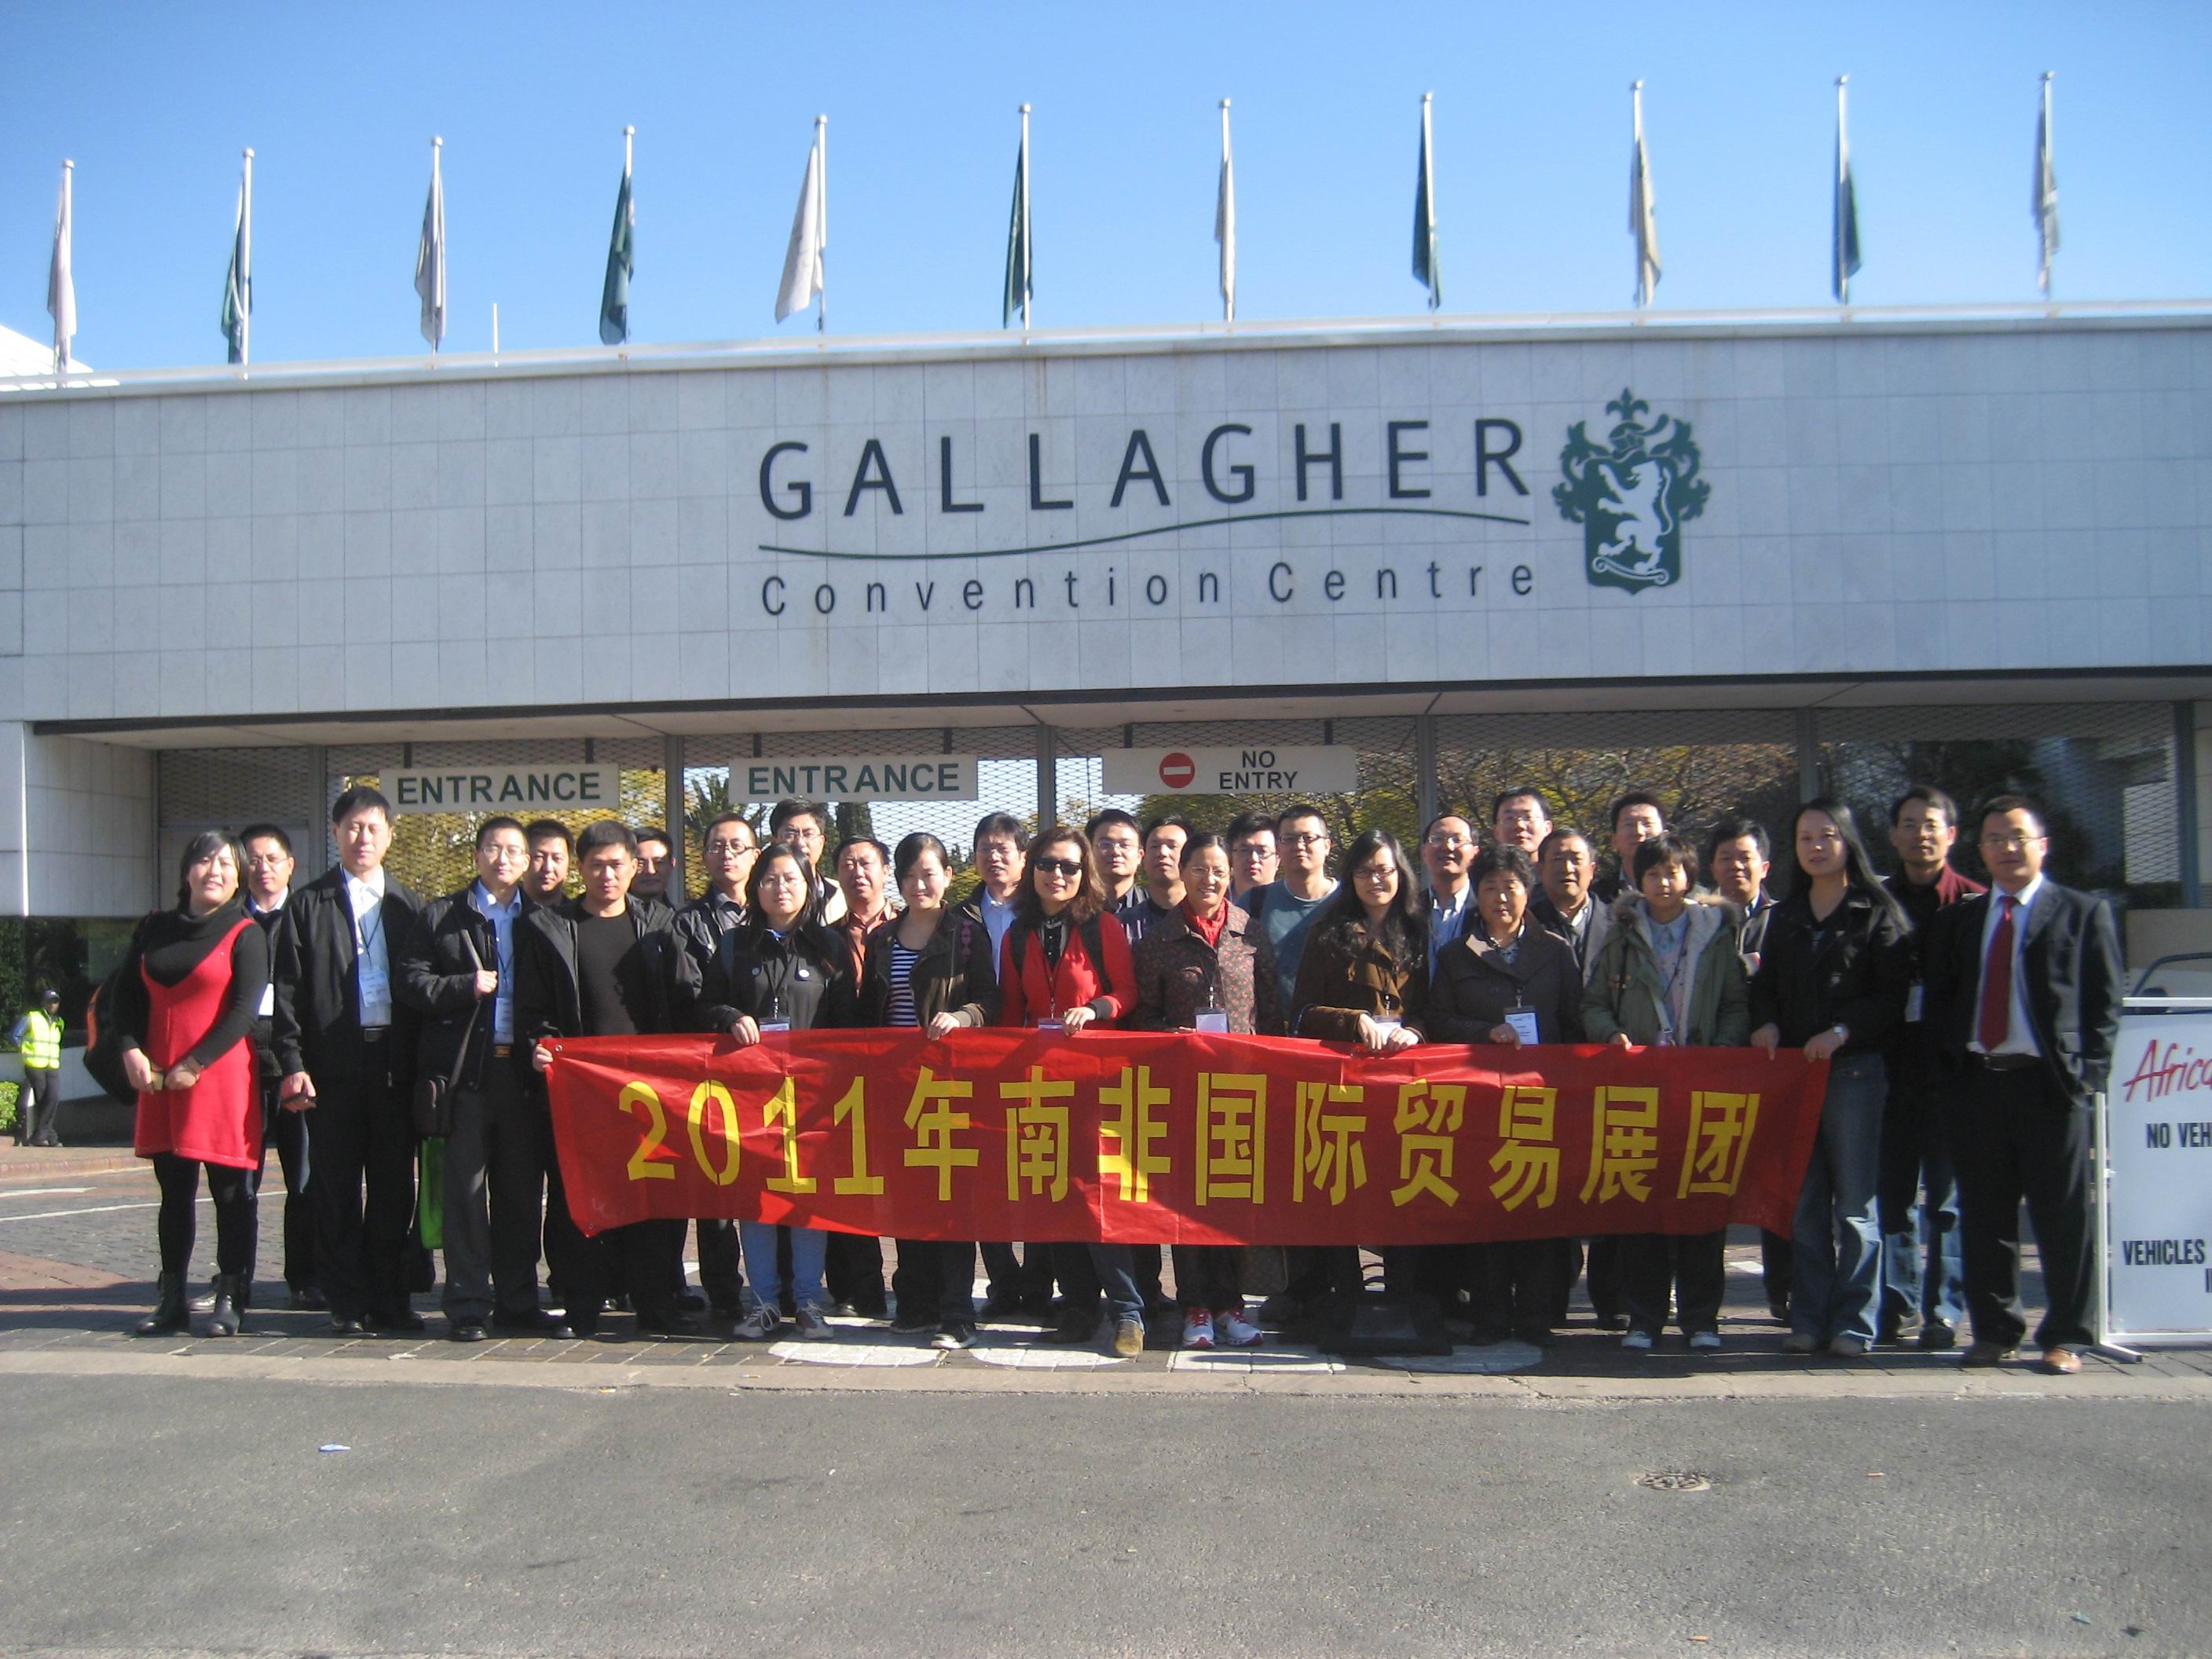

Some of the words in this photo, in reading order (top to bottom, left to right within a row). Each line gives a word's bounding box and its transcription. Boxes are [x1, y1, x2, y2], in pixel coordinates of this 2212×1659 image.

[758, 417, 1531, 522] GALLAGHER
[760, 569, 1220, 617] Convention
[1267, 560, 1534, 605] Centre
[1242, 750, 1276, 768] NO
[397, 771, 601, 805] ENTRANCE
[748, 763, 960, 795] ENTRANCE
[1219, 771, 1298, 790] ENTRY
[618, 1065, 1761, 1213] 2011年南非国际贸易展团
[2146, 1122, 2170, 1148] NO
[2122, 1239, 2205, 1265] VEHICLES
